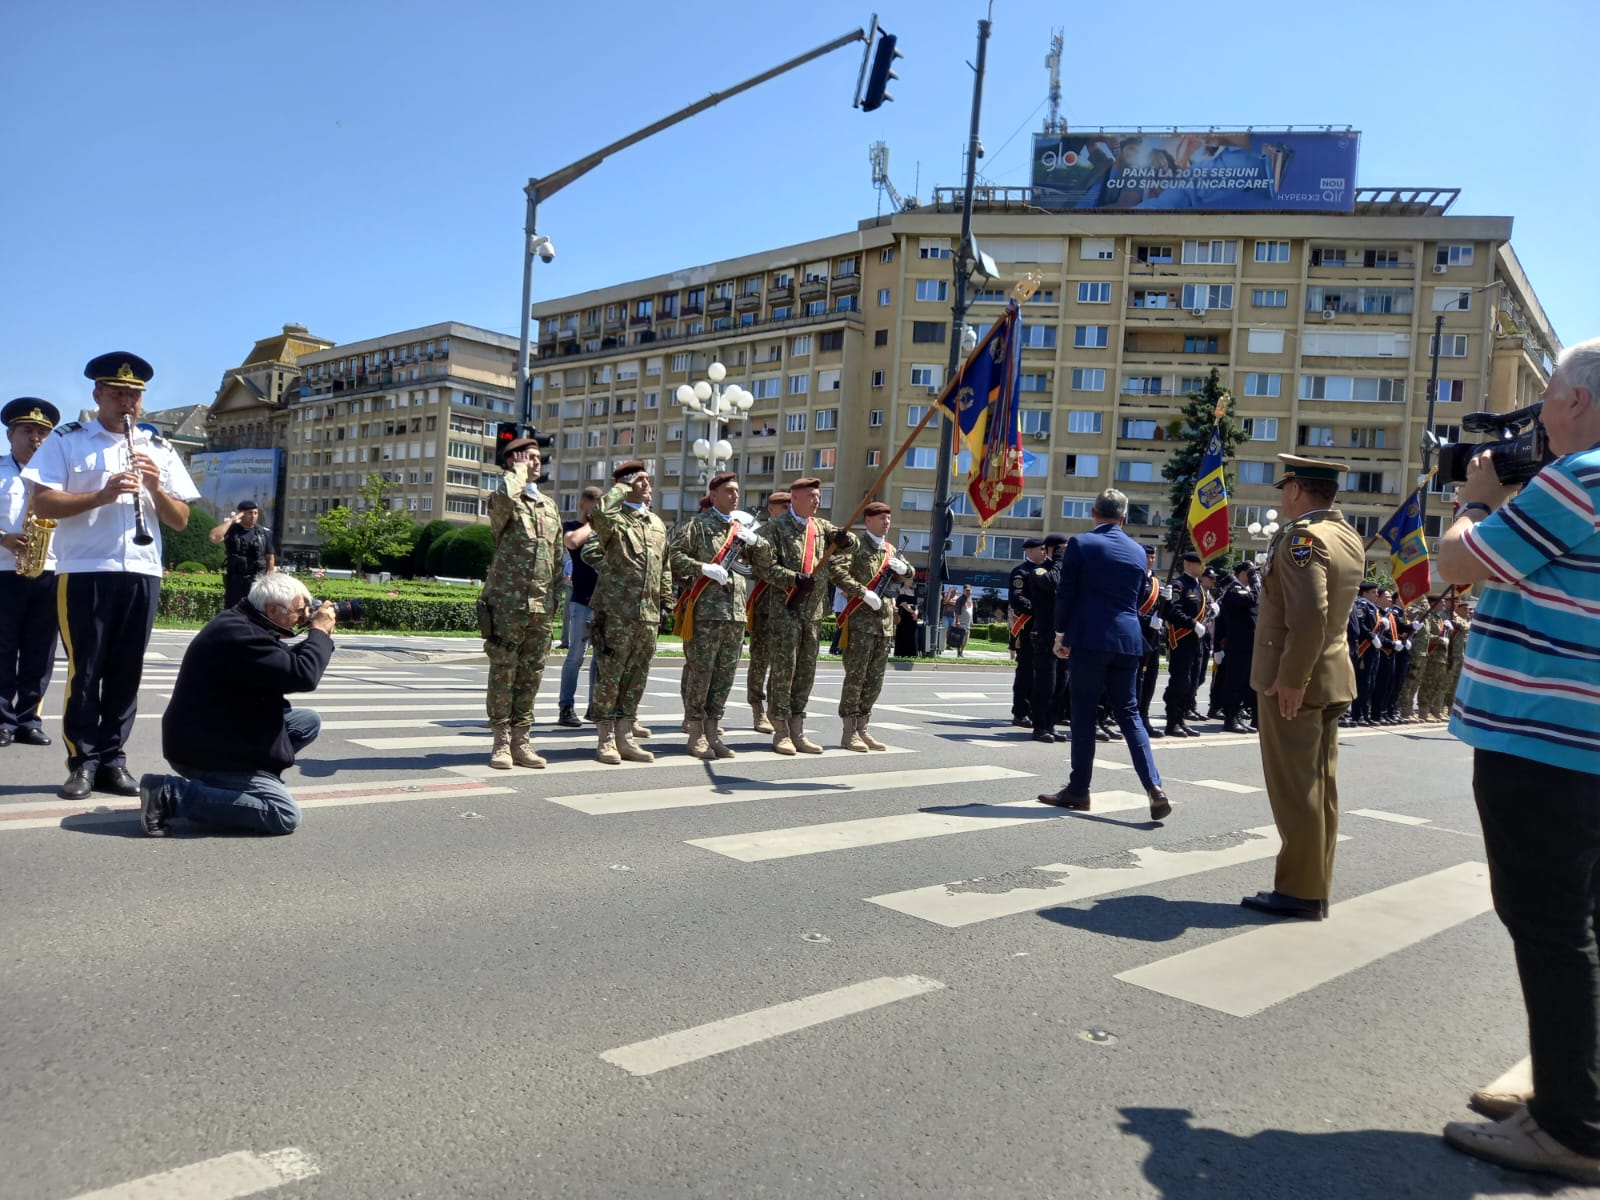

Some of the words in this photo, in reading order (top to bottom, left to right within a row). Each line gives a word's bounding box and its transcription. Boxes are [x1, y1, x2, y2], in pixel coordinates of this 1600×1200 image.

[1041, 142, 1078, 172] glo
[1158, 168, 1173, 178] LA
[1175, 169, 1191, 178] 20
[1192, 168, 1208, 178] DE
[1210, 167, 1259, 177] SESIUNI
[1106, 178, 1125, 188] CU
[1126, 179, 1137, 188] O
[1322, 180, 1343, 188] NOU
